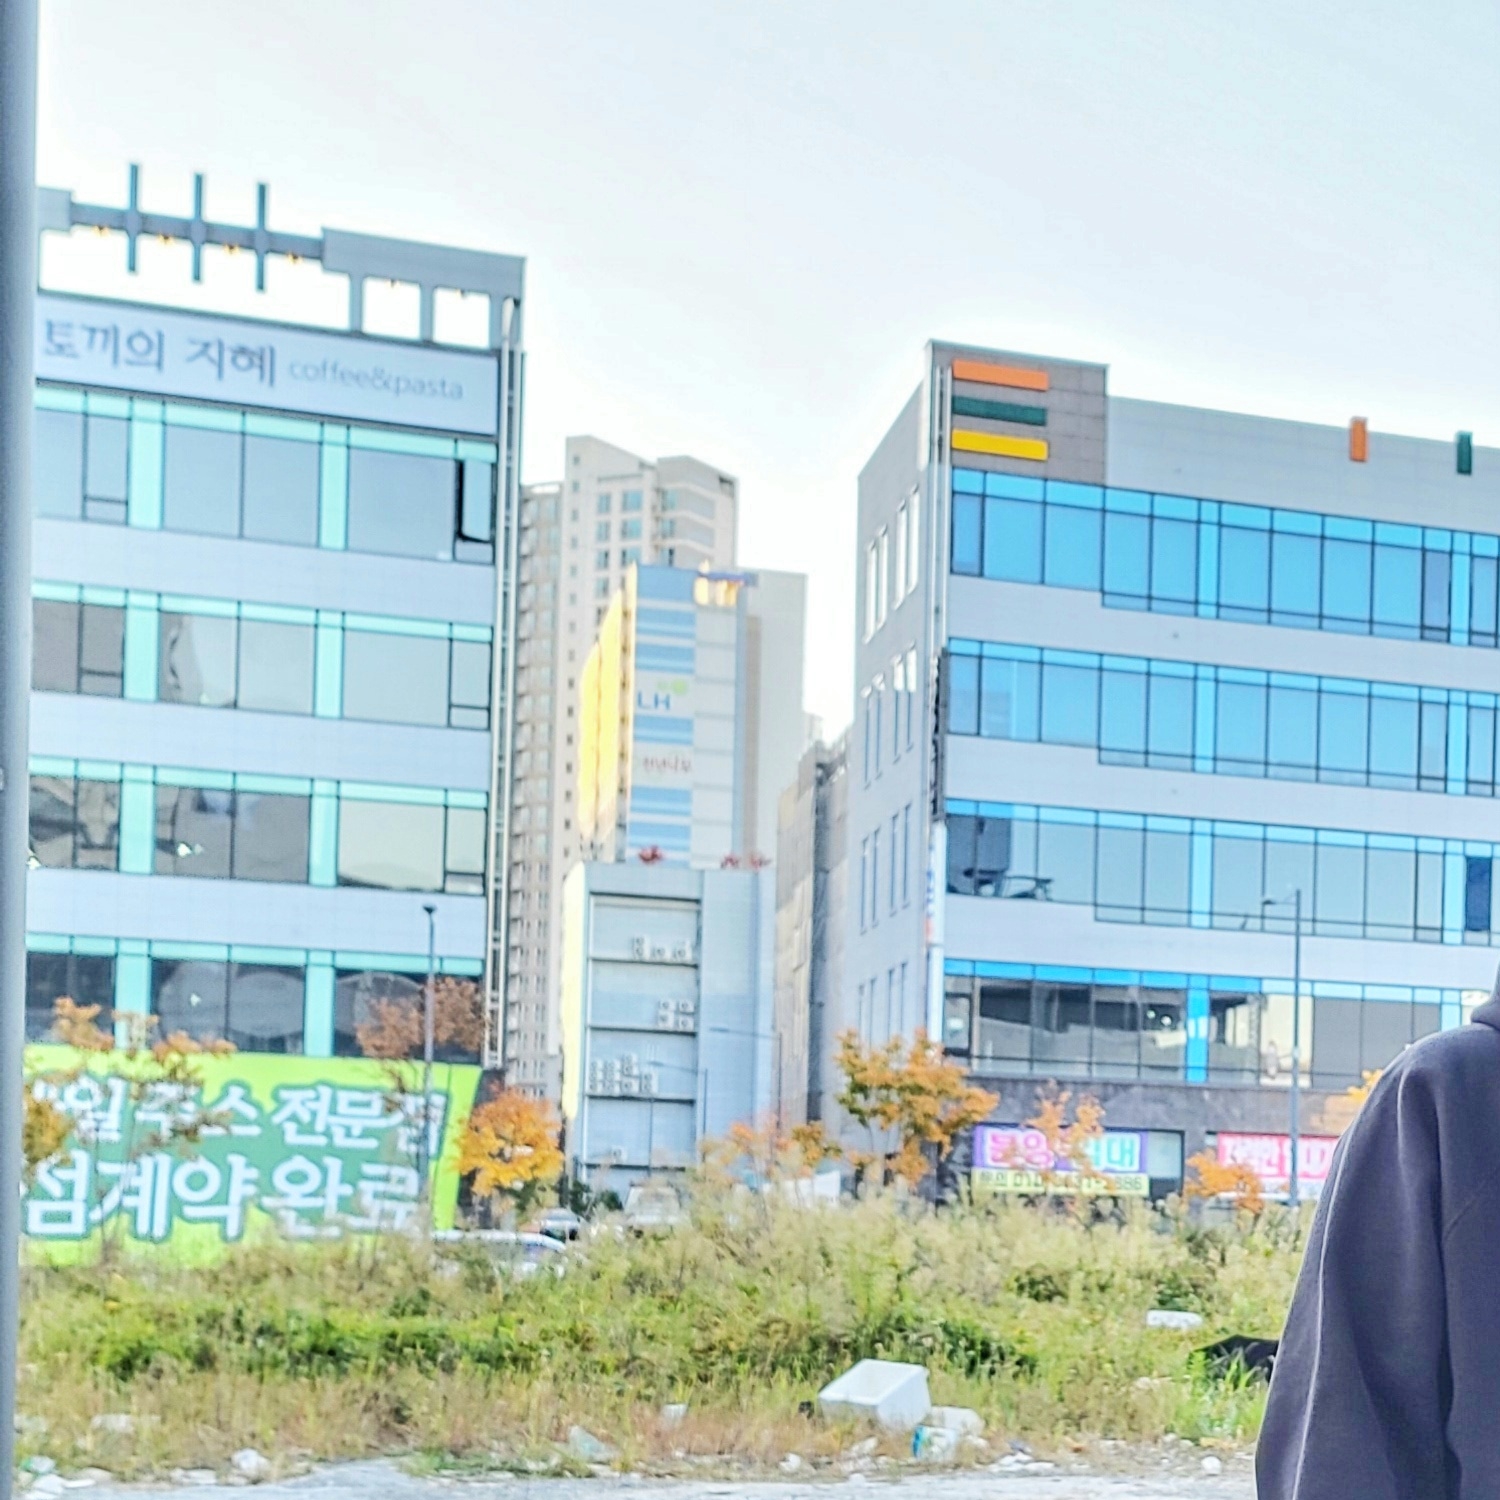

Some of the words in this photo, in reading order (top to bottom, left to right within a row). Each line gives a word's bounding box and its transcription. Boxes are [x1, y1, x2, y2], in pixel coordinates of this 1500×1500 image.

[43, 318, 166, 373] 토끼의
[183, 335, 276, 387] 지혜
[288, 358, 465, 400] coffee&pasta
